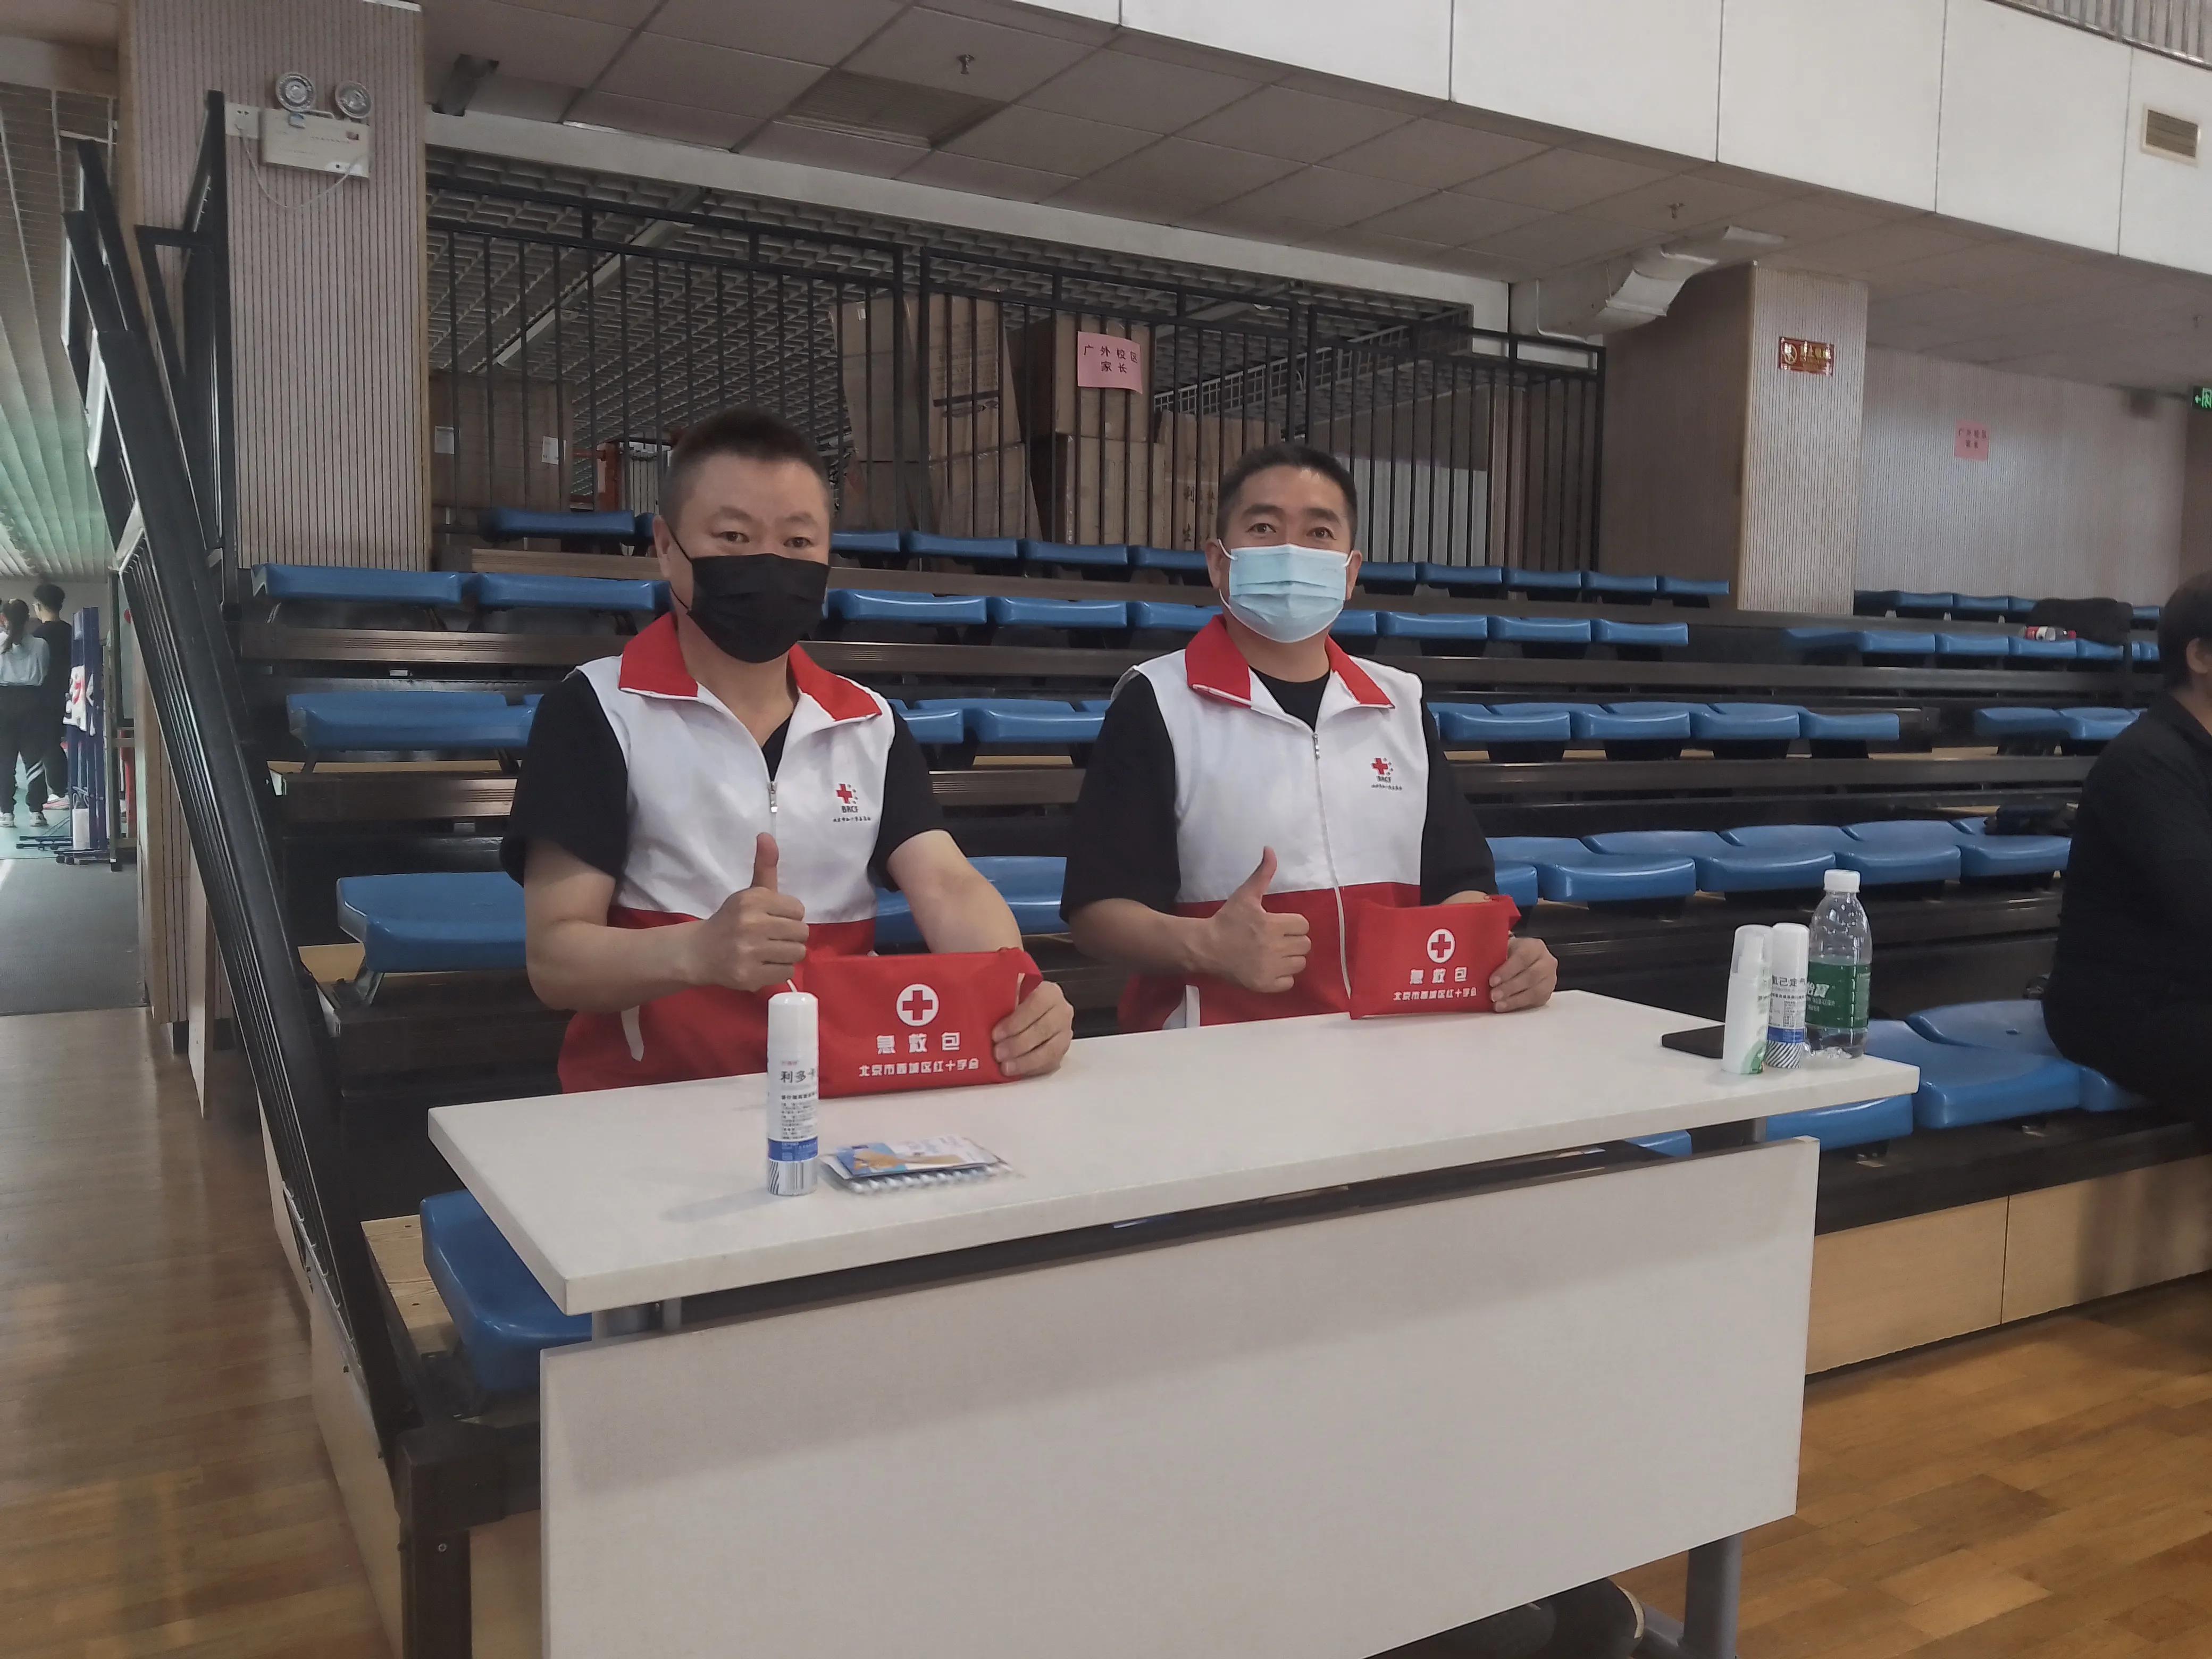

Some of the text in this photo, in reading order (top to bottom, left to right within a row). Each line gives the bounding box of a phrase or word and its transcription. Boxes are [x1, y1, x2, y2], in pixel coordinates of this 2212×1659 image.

[1083, 344, 1138, 364] 广外校区
[1100, 361, 1127, 374] 家长
[876, 1032, 961, 1054] 急救包
